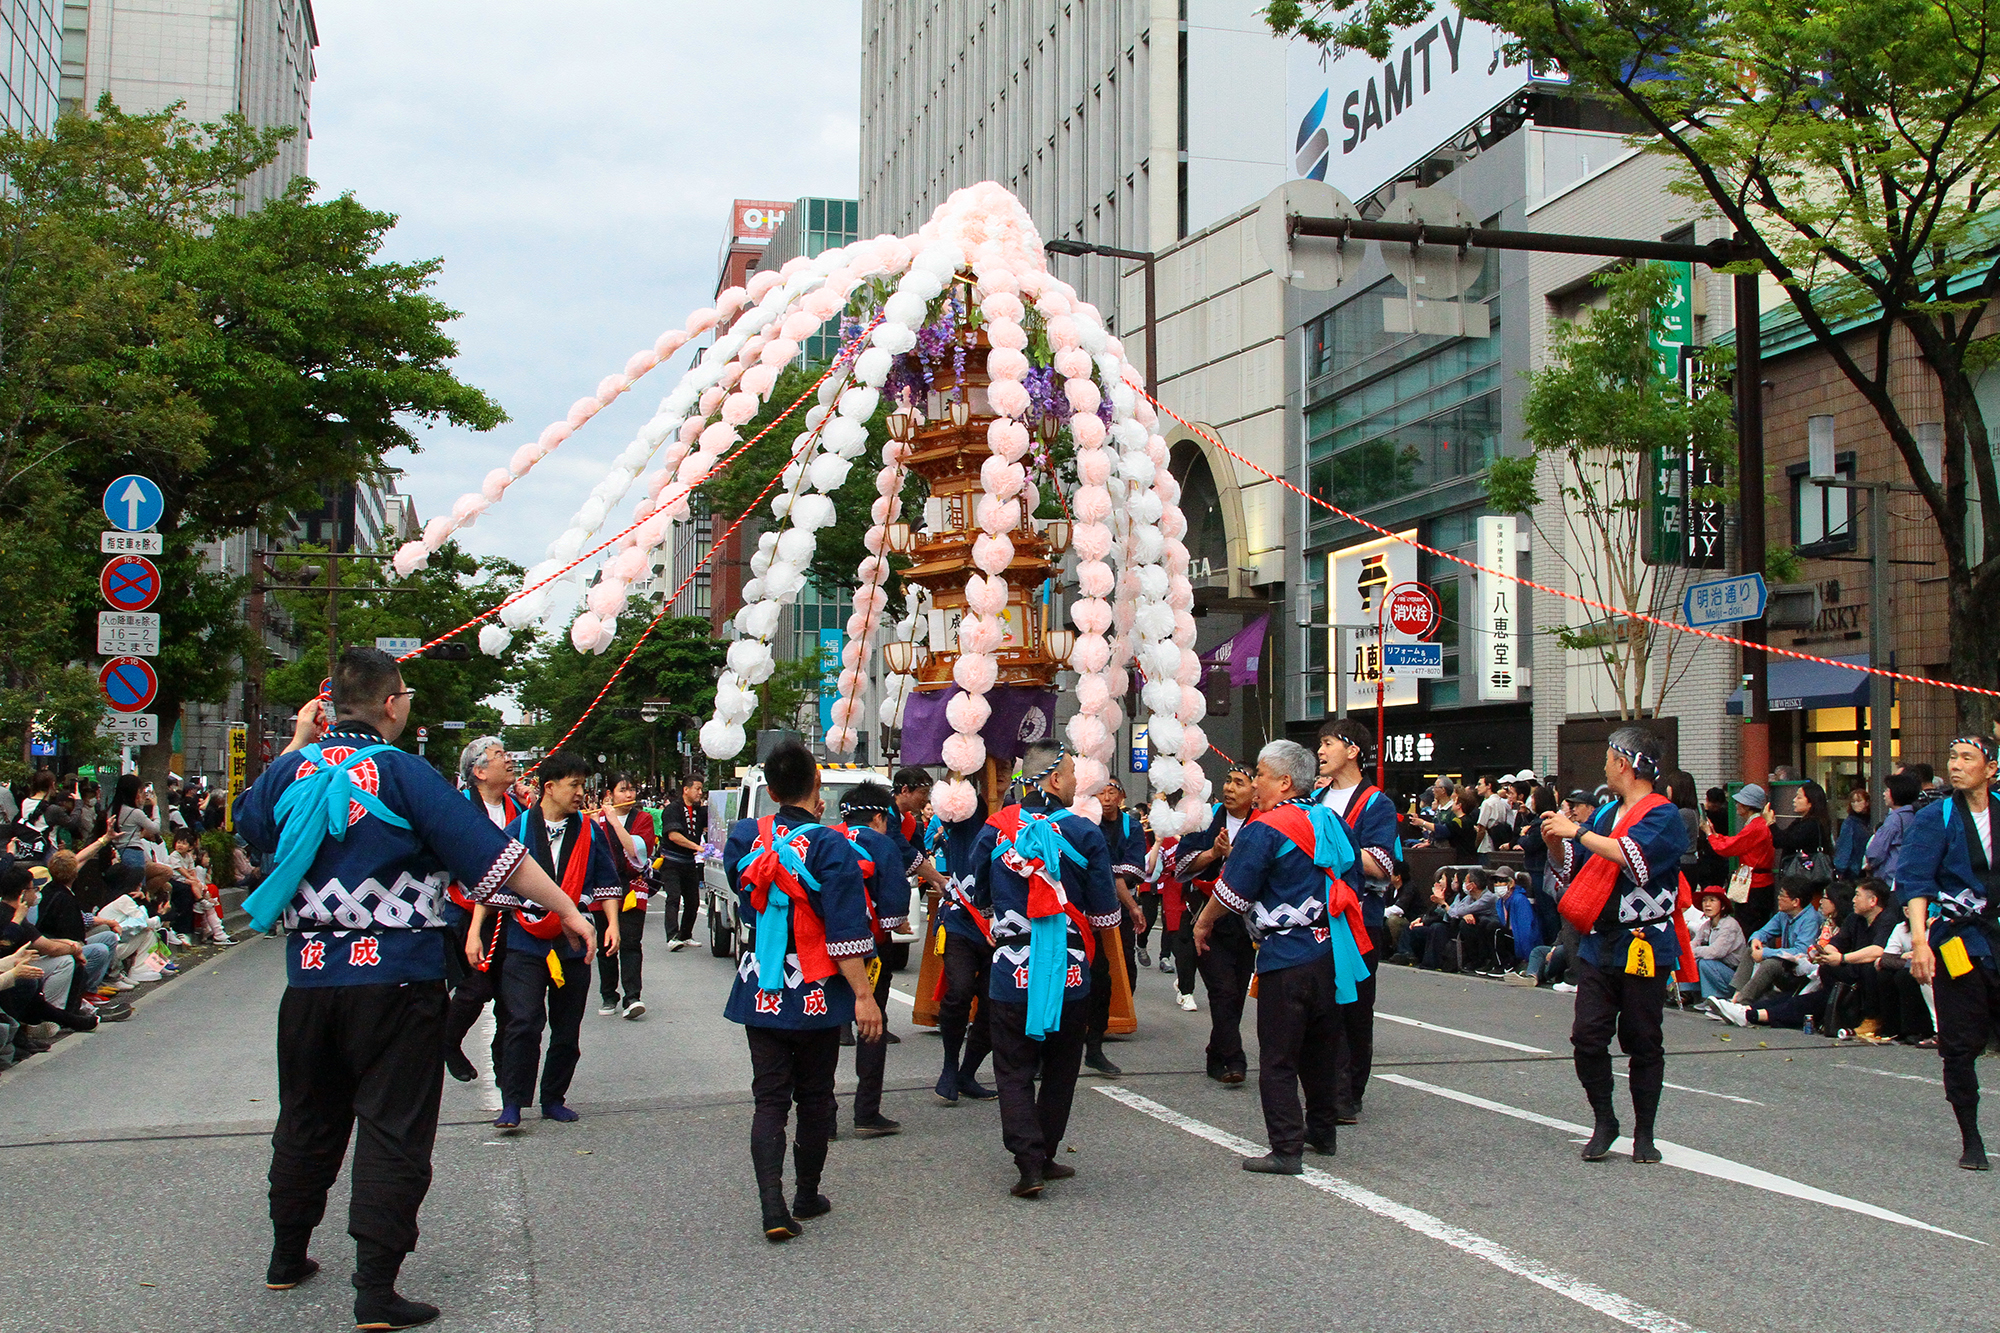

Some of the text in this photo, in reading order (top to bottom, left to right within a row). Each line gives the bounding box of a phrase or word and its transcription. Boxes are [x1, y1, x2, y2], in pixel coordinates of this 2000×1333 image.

[1342, 10, 1465, 155] SAMTY
[107, 537, 158, 551] 指定車を除く
[123, 556, 142, 565] 16-2
[1696, 582, 1750, 609] 明治通り
[1394, 604, 1428, 622] 消火栓
[1705, 604, 1744, 620] Meiji-dori
[101, 614, 158, 627] 人の降車を除く
[1493, 591, 1509, 665] 八恵堂
[104, 642, 155, 653] ここまで
[120, 657, 139, 665] 2-16
[1400, 656, 1440, 665] リノベーション
[107, 717, 148, 729] 2-16
[1384, 734, 1414, 763] 八恵堂
